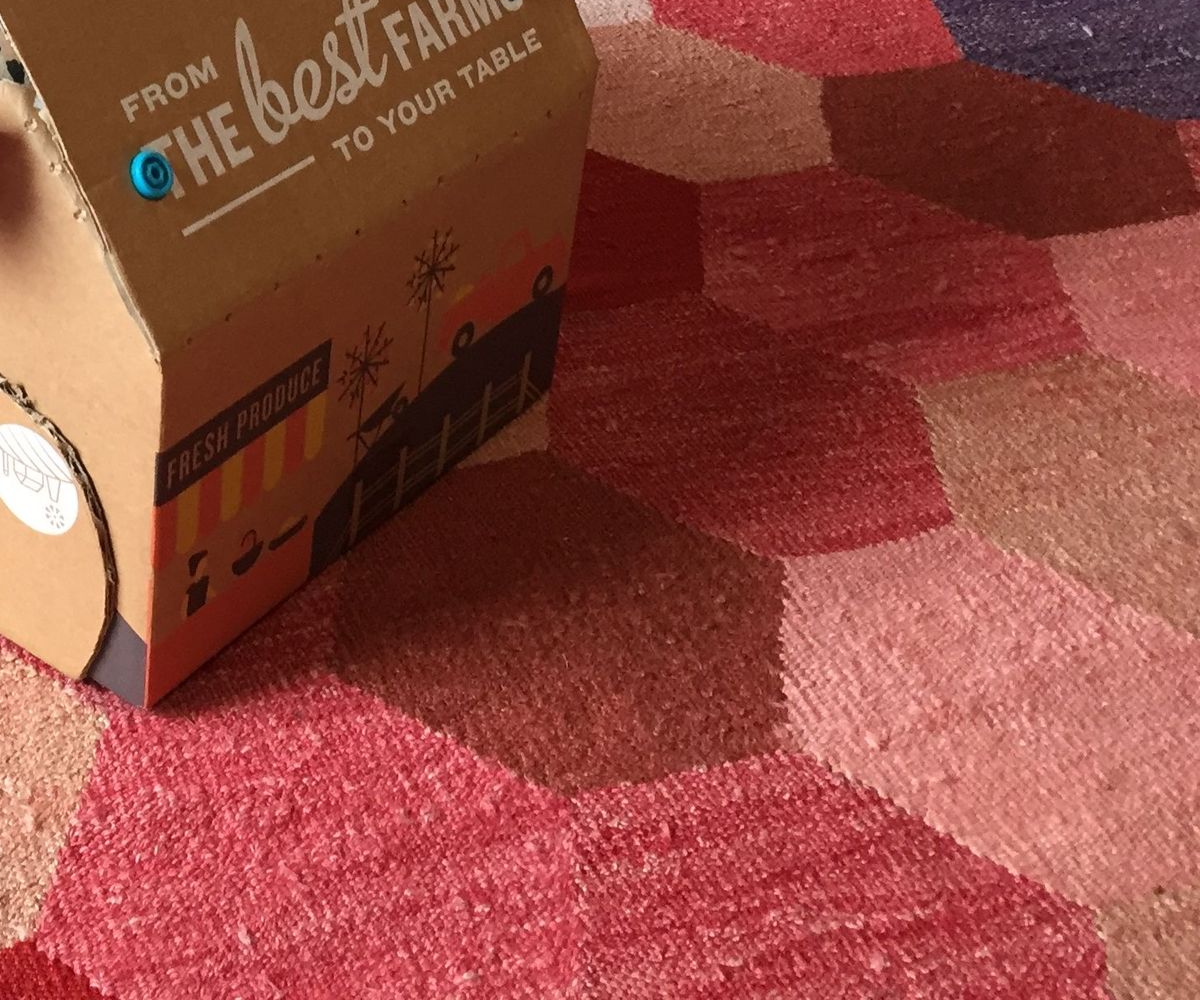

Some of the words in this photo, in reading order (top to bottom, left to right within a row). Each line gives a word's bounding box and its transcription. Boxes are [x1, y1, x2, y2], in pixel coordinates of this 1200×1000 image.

[120, 56, 219, 123] FROM
[331, 125, 374, 162] TO
[377, 83, 457, 136] YOUR
[457, 28, 543, 90] TABLE
[167, 421, 229, 489] FRESH
[236, 358, 323, 440] PRODUCE
